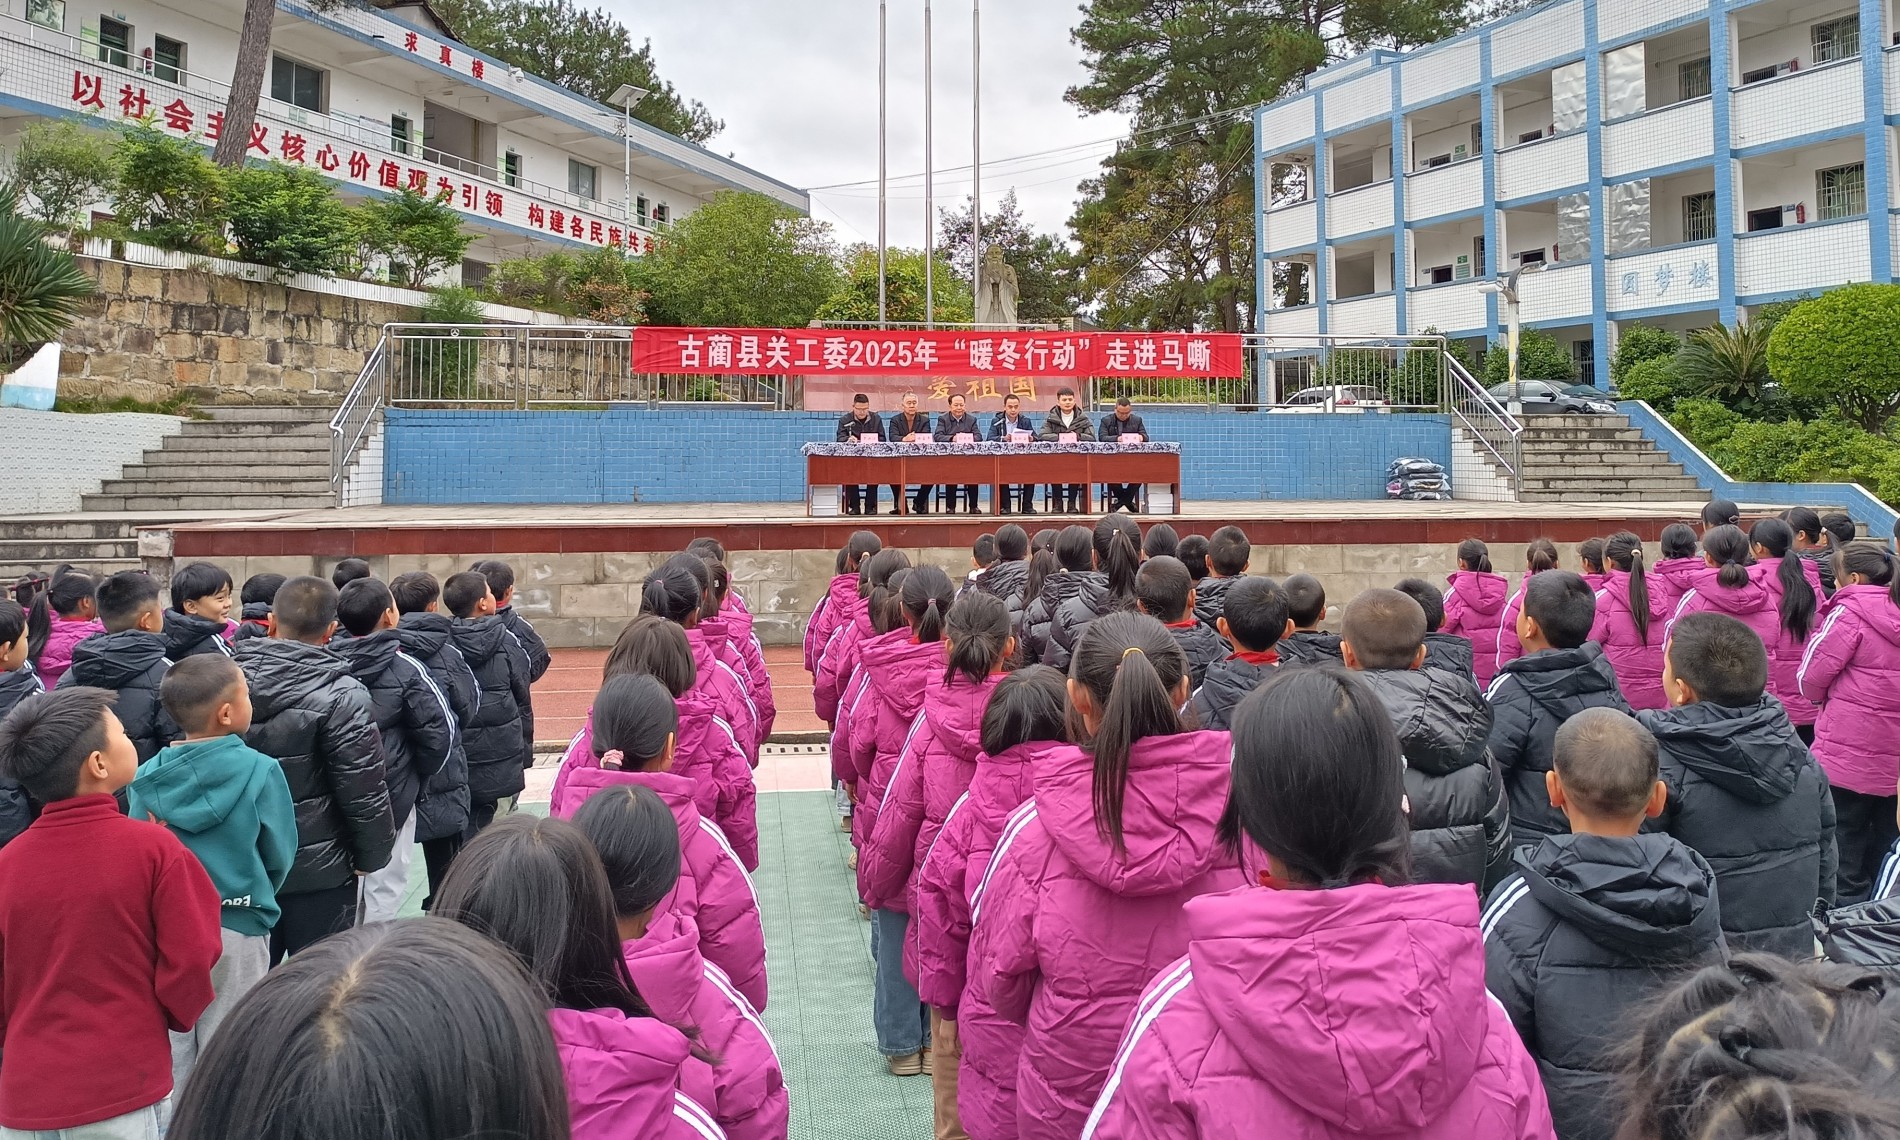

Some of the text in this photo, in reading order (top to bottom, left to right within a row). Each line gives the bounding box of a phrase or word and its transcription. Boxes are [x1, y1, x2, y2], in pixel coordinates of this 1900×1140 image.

[405, 32, 484, 80] 求真楼
[927, 375, 1037, 402] 爱祖国
